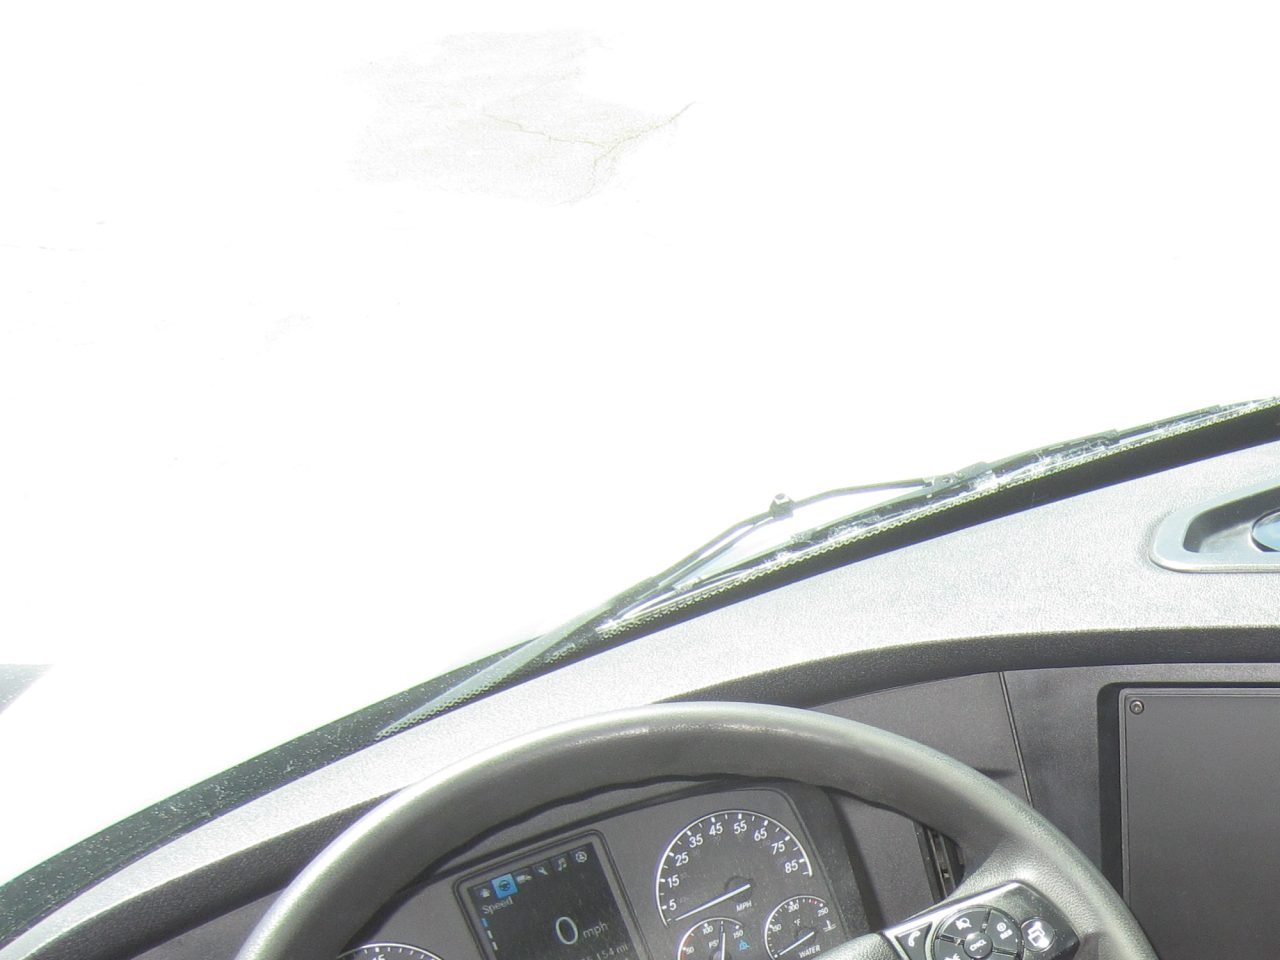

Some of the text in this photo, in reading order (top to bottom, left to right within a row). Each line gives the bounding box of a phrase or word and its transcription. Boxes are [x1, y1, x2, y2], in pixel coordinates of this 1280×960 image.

[709, 822, 723, 836] 45
[733, 820, 747, 835] 55
[754, 827, 768, 842] 65
[689, 834, 704, 848] 35
[771, 841, 786, 856] 75
[675, 852, 689, 867] 25
[785, 860, 799, 874] 85
[667, 875, 680, 889] 15
[482, 897, 513, 915] Speed
[669, 899, 677, 911] 5
[736, 901, 752, 913] MPH
[555, 916, 608, 945] 0 mph
[799, 945, 822, 959] WATER
